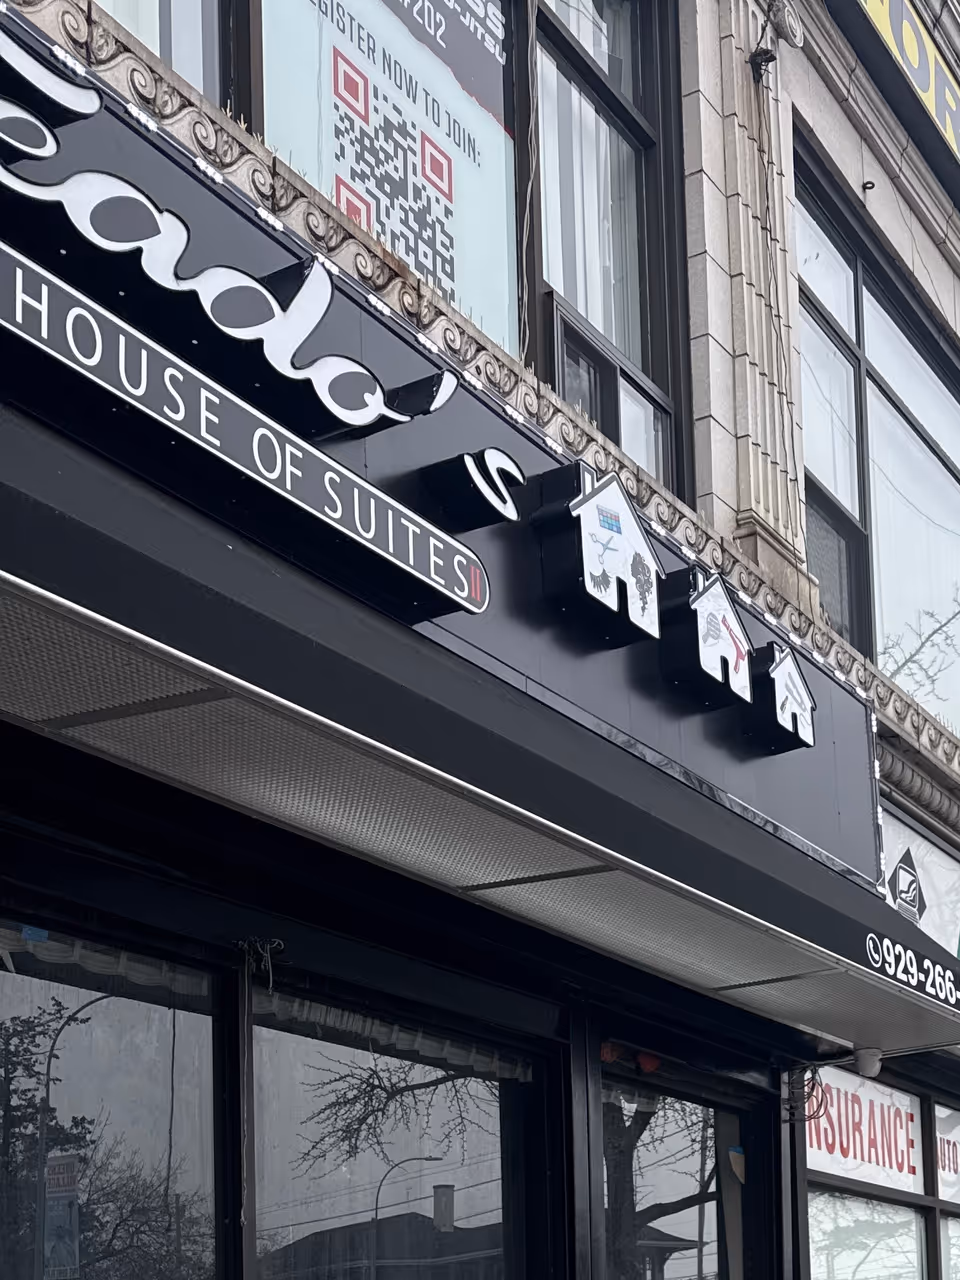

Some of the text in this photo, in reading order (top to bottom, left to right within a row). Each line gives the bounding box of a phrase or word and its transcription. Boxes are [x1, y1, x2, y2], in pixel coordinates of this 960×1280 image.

[381, 46, 418, 105] NOW
[422, 87, 441, 128] TO
[444, 109, 481, 168] JOIN:
[14, 267, 222, 448] HOUSE
[251, 426, 304, 492] OF
[323, 470, 470, 600] SUITES
[805, 1077, 916, 1176] NSURANCE
